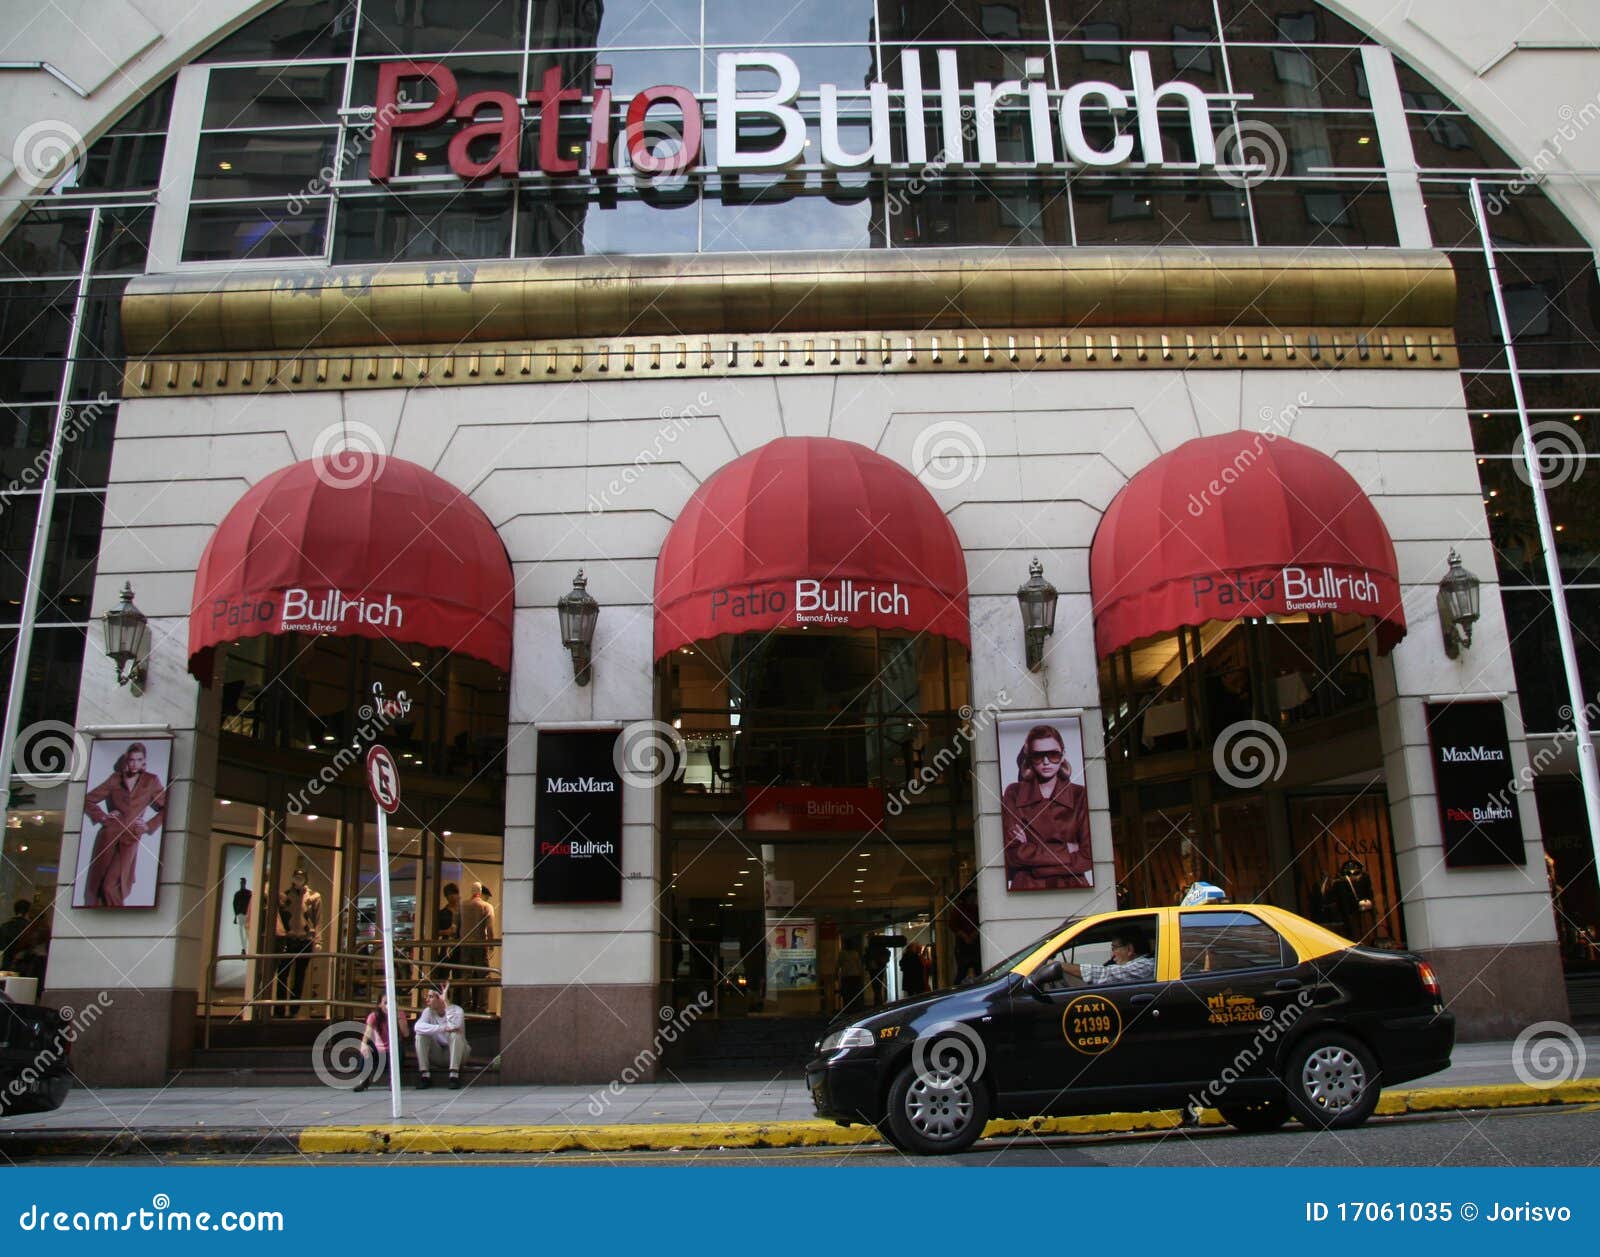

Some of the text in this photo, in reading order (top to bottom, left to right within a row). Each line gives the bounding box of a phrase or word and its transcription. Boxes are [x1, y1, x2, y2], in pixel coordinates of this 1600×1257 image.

[1192, 567, 1380, 609] Patio Bullrich
[711, 579, 909, 621] Patio Bullrich
[1286, 600, 1338, 610] Buenos Aires
[212, 588, 403, 631] Patio Bullrich
[796, 613, 849, 623] Buenos Aires
[281, 622, 337, 632] Buenos Aires
[1441, 745, 1504, 763] MaxMara
[546, 776, 614, 794] MaxMara
[1074, 1003, 1106, 1013] TAXI
[1073, 1016, 1111, 1034] 21399
[1078, 1036, 1110, 1046] GCBA
